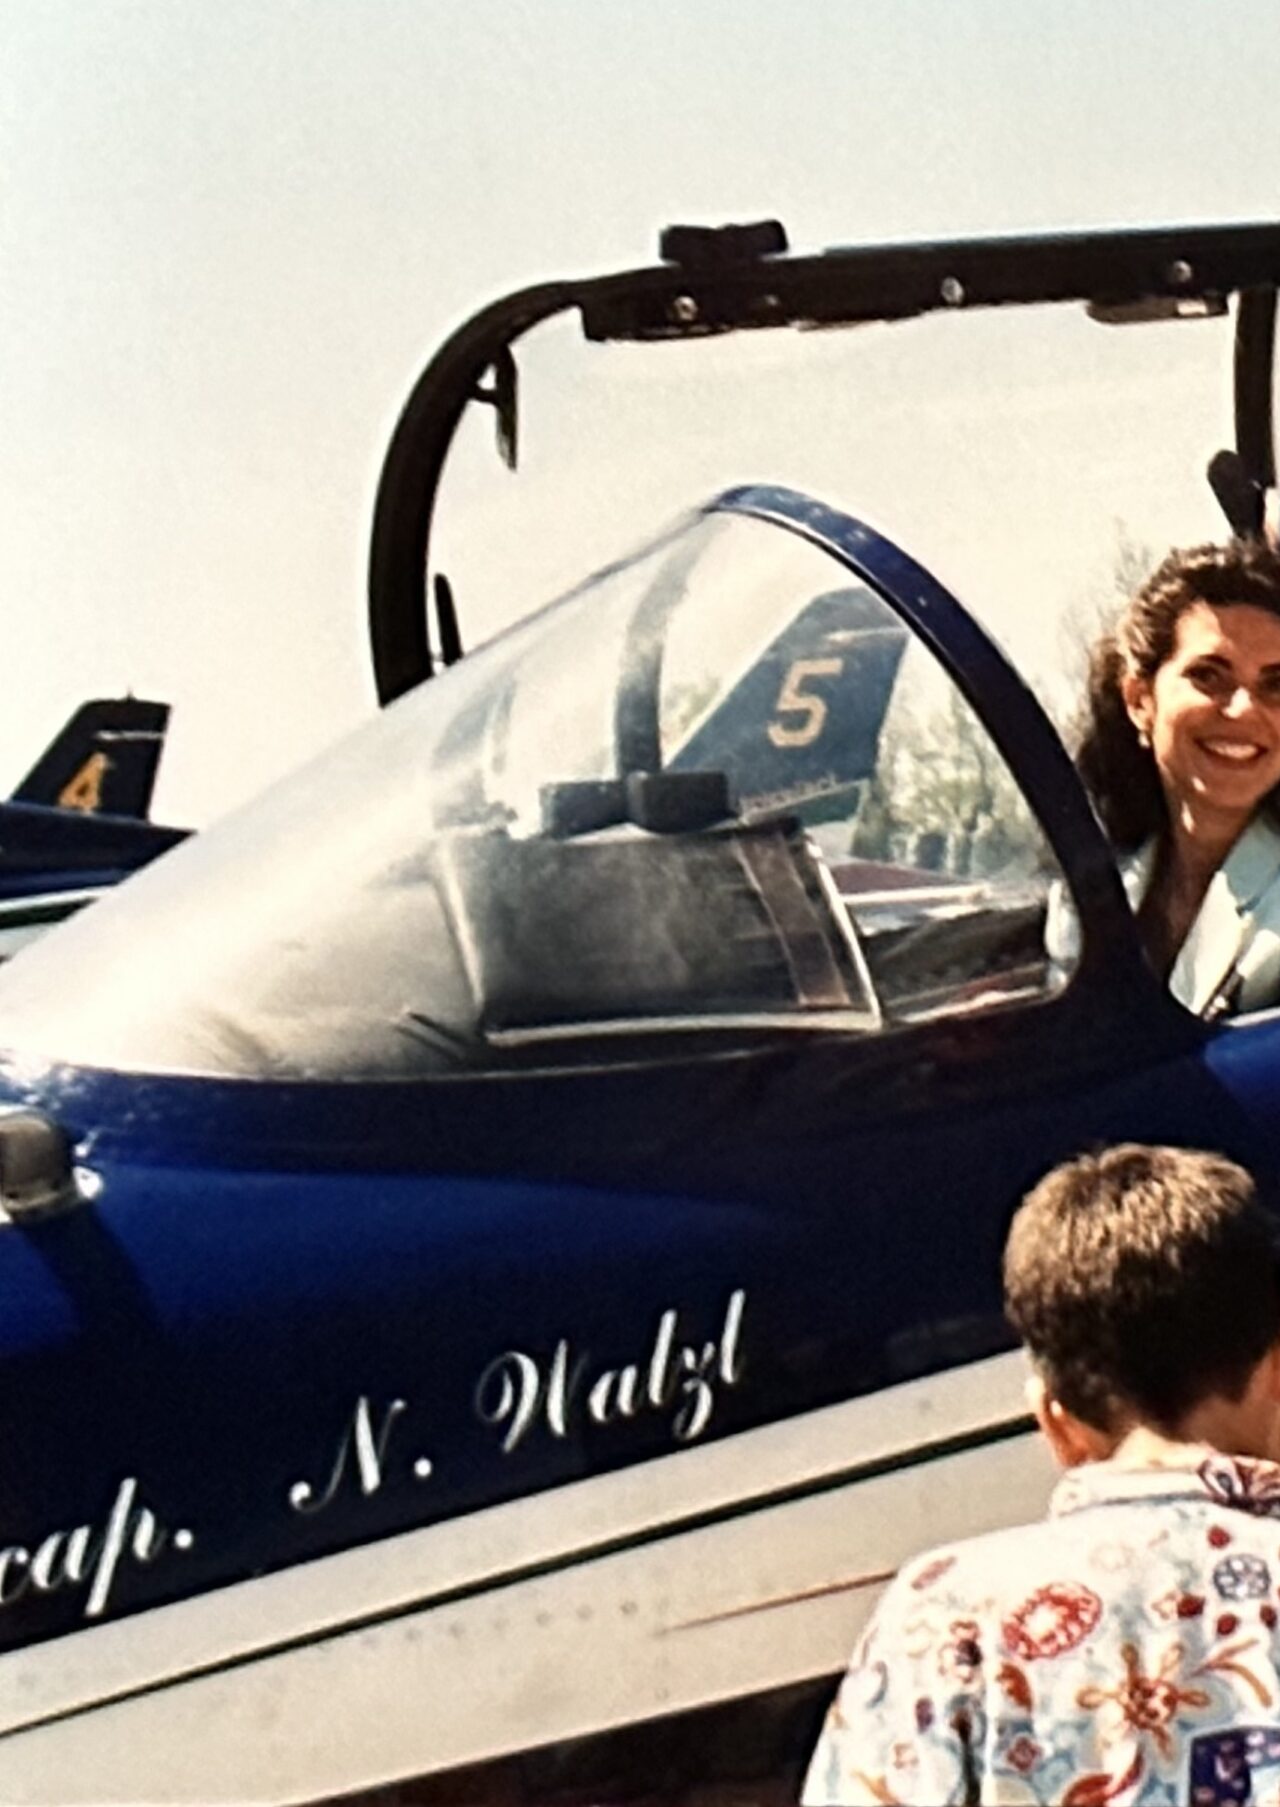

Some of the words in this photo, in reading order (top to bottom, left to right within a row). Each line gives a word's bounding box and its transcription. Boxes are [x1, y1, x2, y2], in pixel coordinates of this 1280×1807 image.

[766, 656, 844, 748] 5
[58, 751, 109, 816] 4
[0, 1477, 193, 1617] cap.
[289, 1395, 433, 1510] N.
[475, 1289, 746, 1453] Walzl
